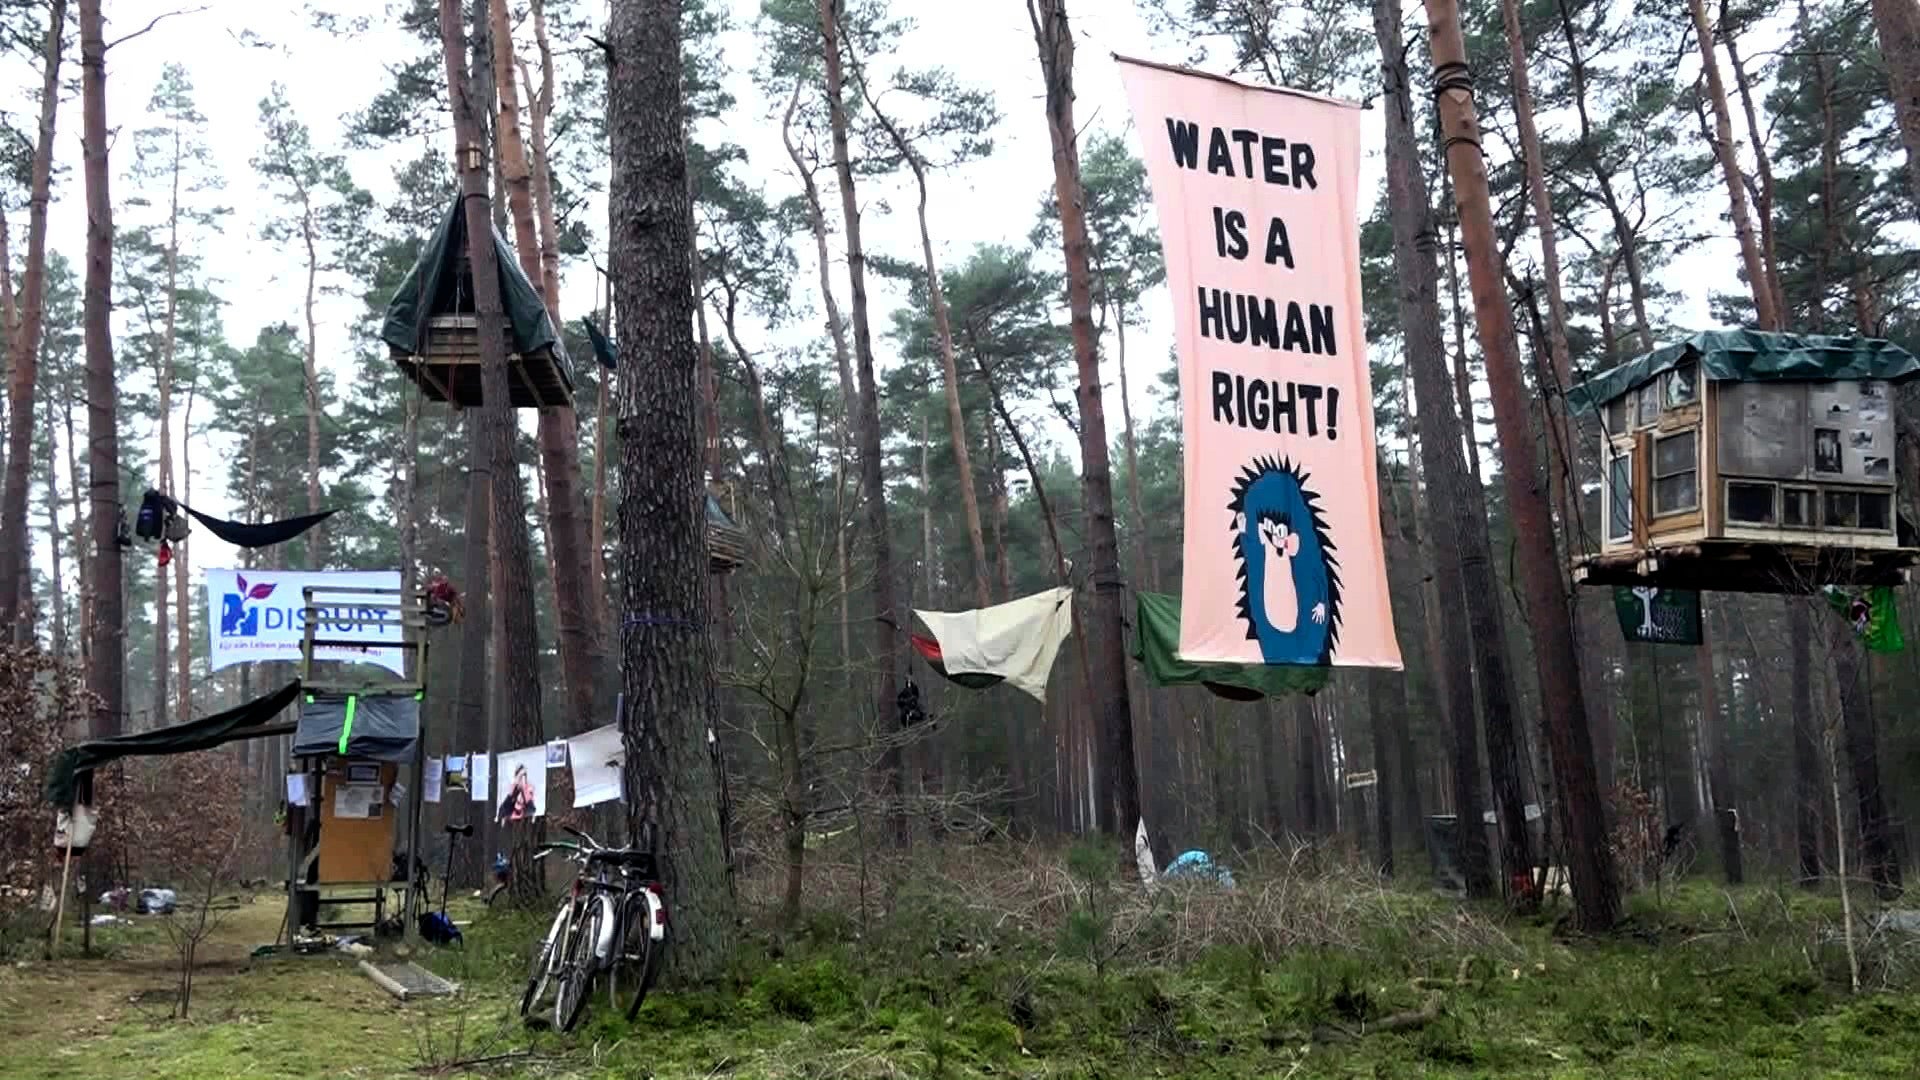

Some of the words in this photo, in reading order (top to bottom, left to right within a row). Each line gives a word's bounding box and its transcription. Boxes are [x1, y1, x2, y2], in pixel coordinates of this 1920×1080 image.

[1165, 117, 1318, 190] WATER
[1213, 206, 1249, 260] IS
[1265, 217, 1295, 269] A
[1198, 286, 1337, 356] HUMAN
[1212, 371, 1340, 440] RIGHT!
[265, 607, 388, 633] DISRUPT
